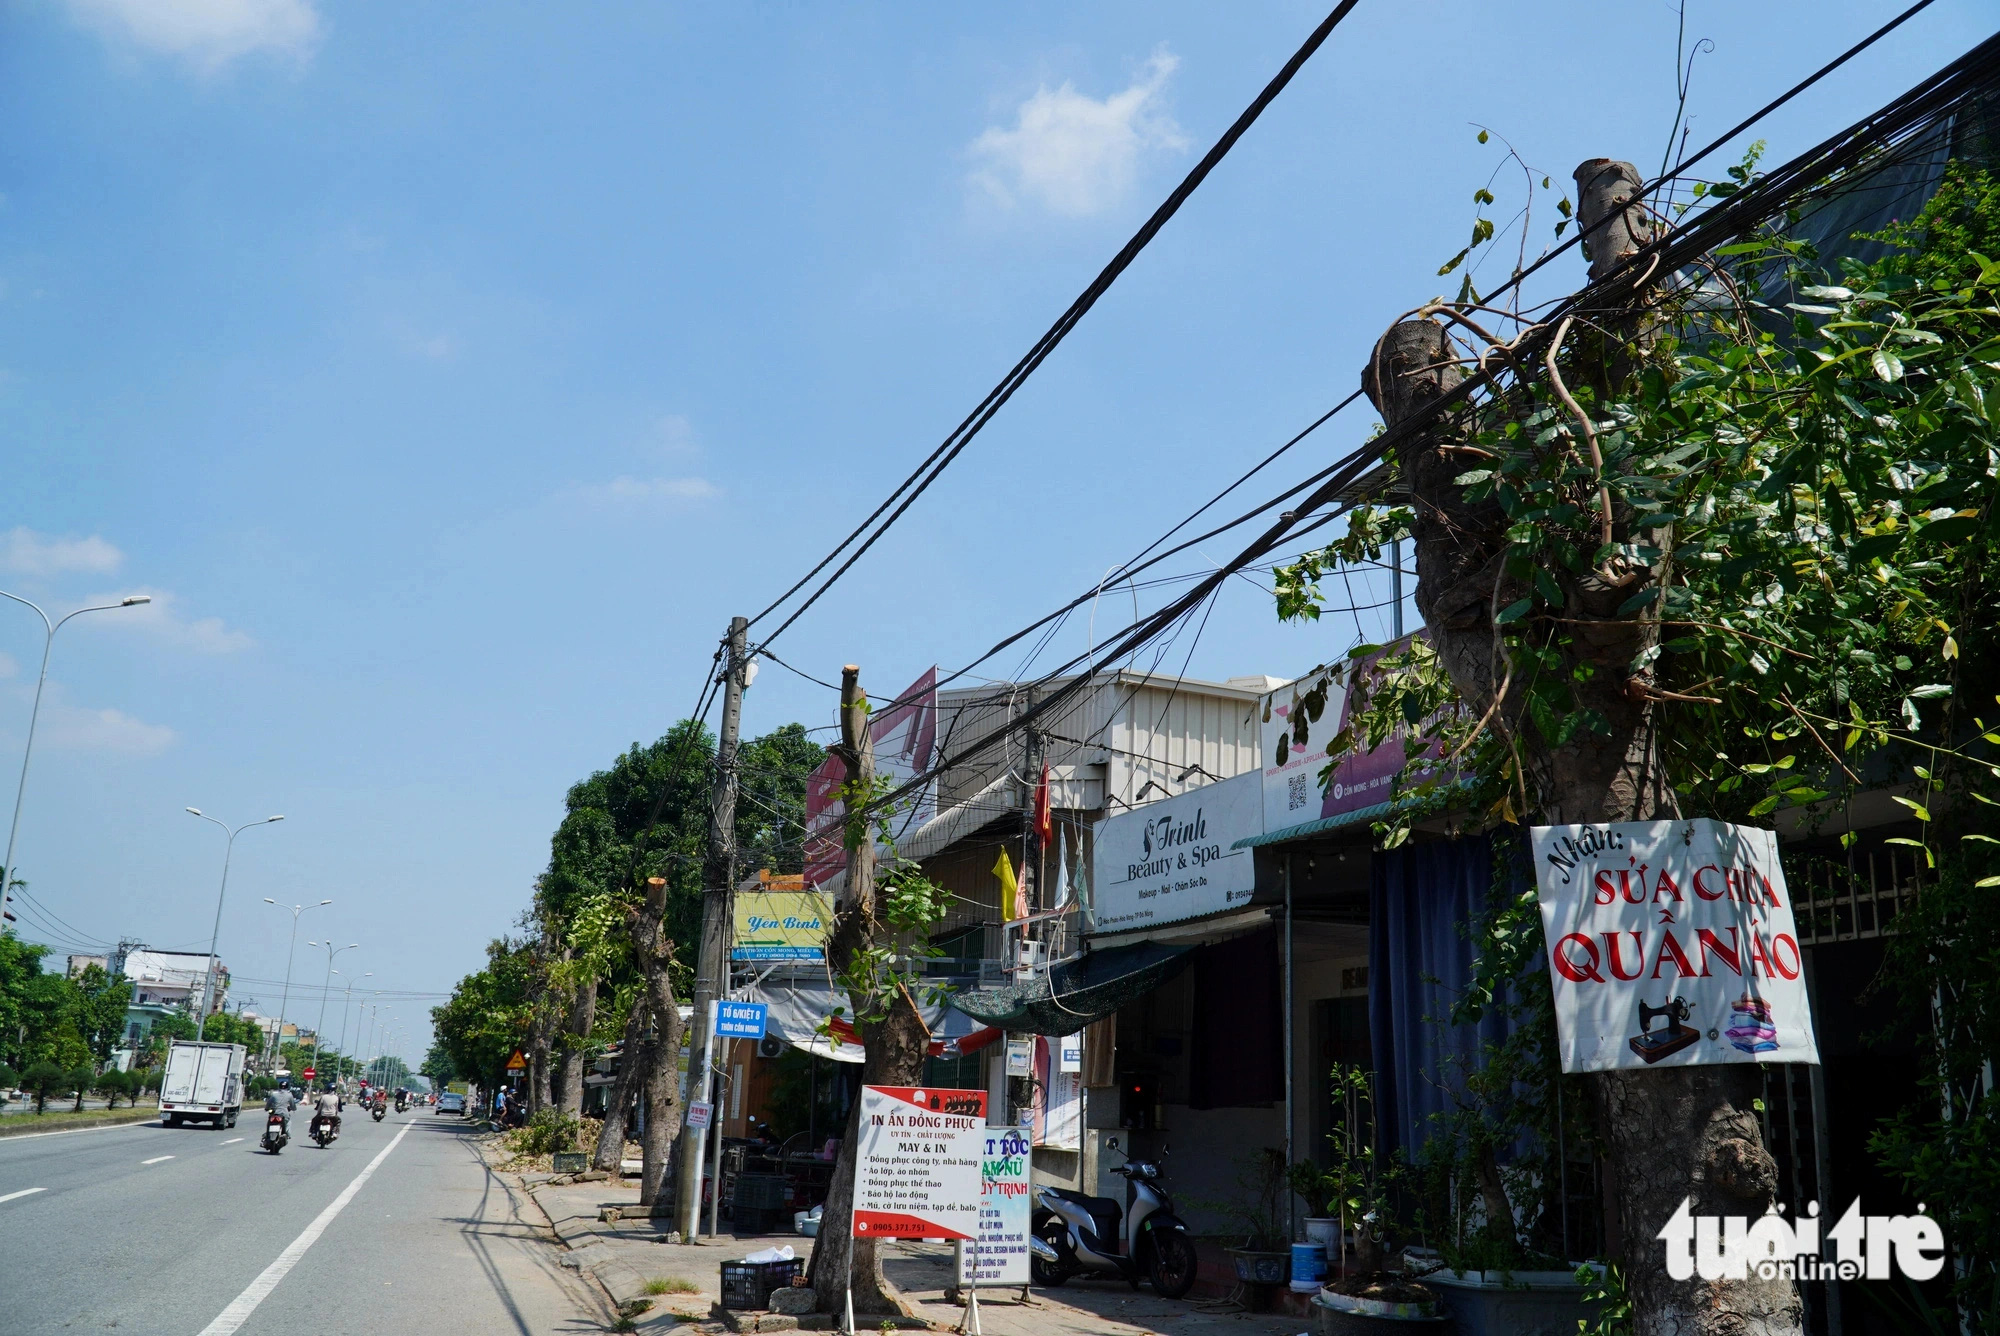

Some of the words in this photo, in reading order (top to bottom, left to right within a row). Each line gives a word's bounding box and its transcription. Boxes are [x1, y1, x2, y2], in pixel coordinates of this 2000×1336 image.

[1353, 781, 1367, 794] MONG
[1380, 773, 1393, 785] VANG
[1547, 824, 1624, 884] Nhận:
[1127, 856, 1173, 882] Beauty
[1177, 851, 1188, 871] &
[1192, 844, 1220, 868] Spa
[1138, 888, 1157, 900] Makeup
[1161, 884, 1171, 895] Nail
[1199, 876, 1208, 886] Da
[1593, 855, 1685, 905] SỬA
[1692, 862, 1782, 908] CHỮA
[1553, 908, 1743, 983] QUẦN
[1751, 918, 1800, 981] ÁO
[723, 1004, 733, 1018] TỔ
[733, 1007, 755, 1021] 6/KIỆT
[755, 1010, 761, 1020] 8
[721, 1021, 734, 1032] THÔN
[745, 1024, 760, 1034] MONG
[871, 1114, 884, 1126] IN
[888, 1109, 904, 1127] ẤN
[909, 1110, 941, 1128] ĐỒNG
[945, 1117, 976, 1132] PHỤC
[890, 1130, 899, 1138] UY
[901, 1129, 911, 1138] TÍN
[917, 1130, 933, 1139] CHẤT
[934, 1132, 956, 1141] LƯỢNG
[898, 1142, 920, 1153] MAY
[923, 1143, 931, 1153] &
[935, 1143, 947, 1154] IN
[1000, 1134, 1029, 1156] TÓC
[870, 1154, 890, 1164] Đồng
[891, 1156, 910, 1166] phục
[912, 1157, 930, 1166] công
[932, 1158, 941, 1166] ty,
[942, 1157, 957, 1165] nhà
[959, 1158, 978, 1168] hàng
[982, 1161, 1001, 1176] AM
[1004, 1156, 1024, 1176] NỮ
[868, 1165, 879, 1174] Áo
[880, 1167, 895, 1176] lớp,
[908, 1168, 930, 1176] nhóm
[868, 1177, 888, 1188] Đồng
[890, 1180, 909, 1189] phục
[925, 1180, 942, 1188] thao
[884, 1190, 893, 1200] hộ
[895, 1190, 908, 1198] lao
[909, 1191, 929, 1200] động
[996, 1182, 1028, 1200] TRINH
[894, 1202, 907, 1210] lưu
[909, 1202, 930, 1212] niệm,
[932, 1204, 945, 1213] tạp
[960, 1204, 977, 1212] balo
[873, 1223, 926, 1232] 0905.371.751
[994, 1245, 1008, 1254] DESIGN
[997, 1258, 1008, 1267] SINH
